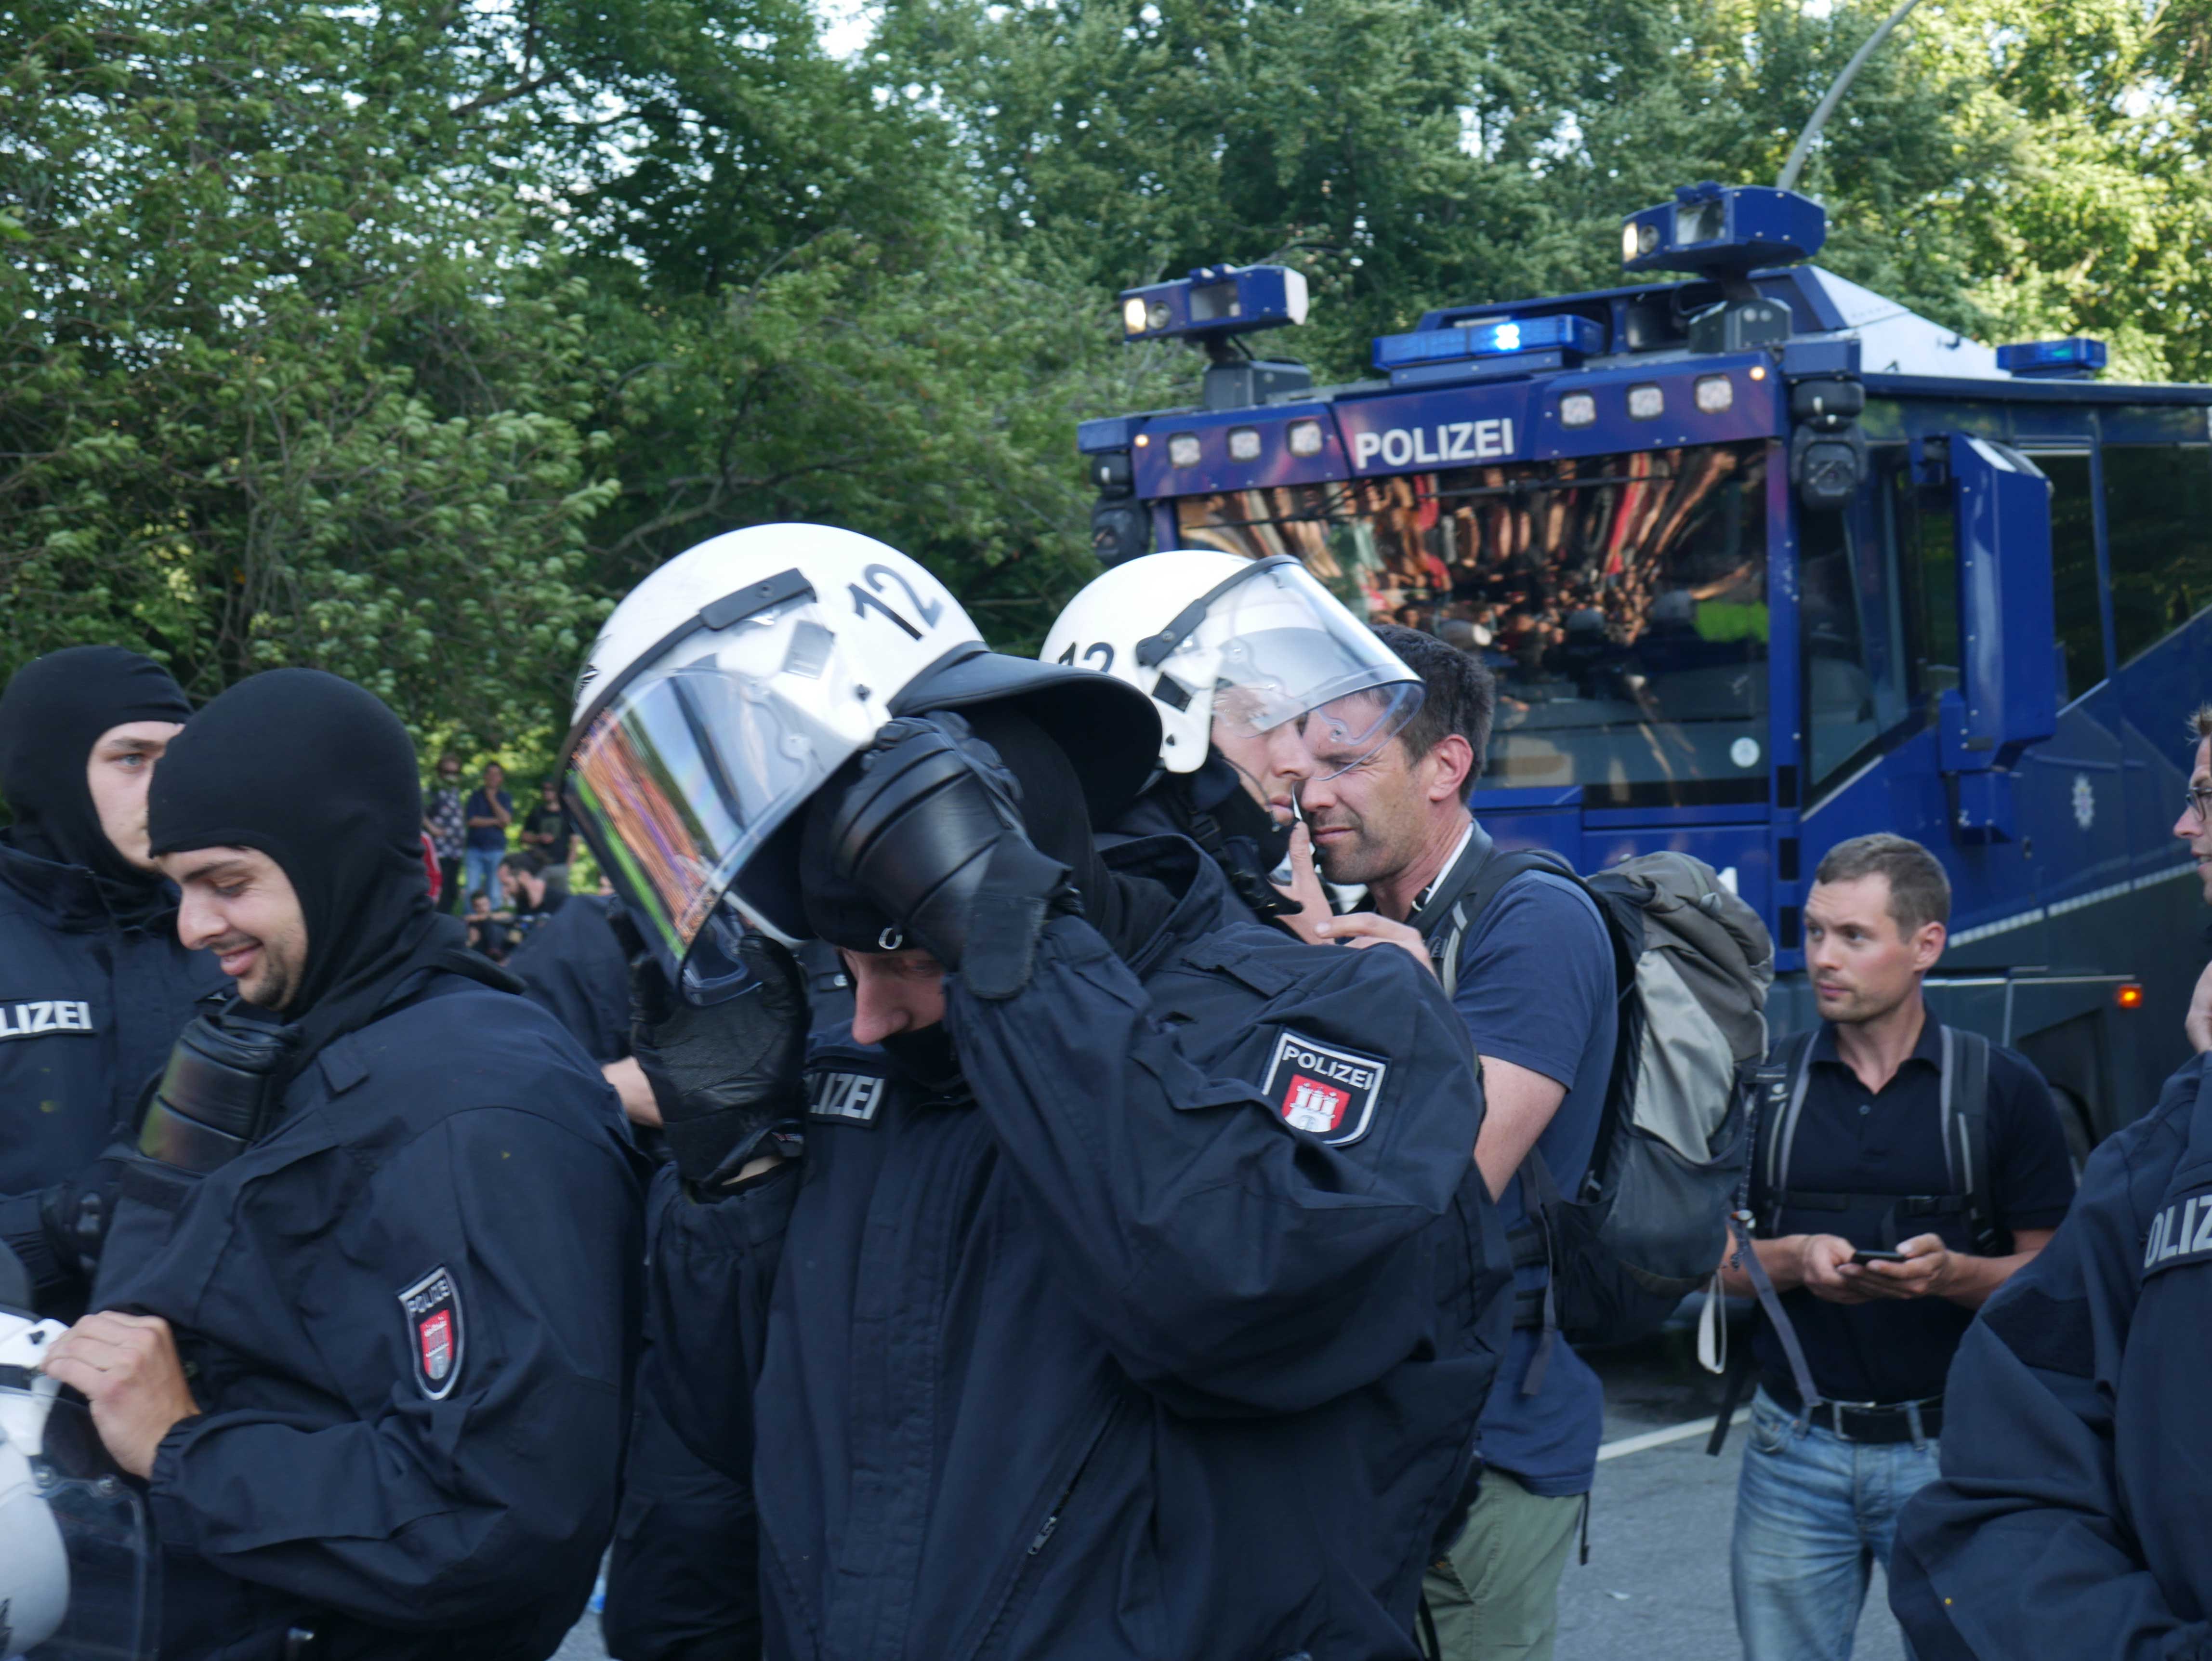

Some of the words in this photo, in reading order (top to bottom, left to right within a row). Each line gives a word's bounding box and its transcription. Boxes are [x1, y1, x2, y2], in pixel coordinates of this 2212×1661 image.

[1355, 418, 1514, 469] POLIZEI
[848, 563, 944, 641] 12
[1282, 1045, 1374, 1090] POLIZEI
[803, 1072, 885, 1120] LIZEI
